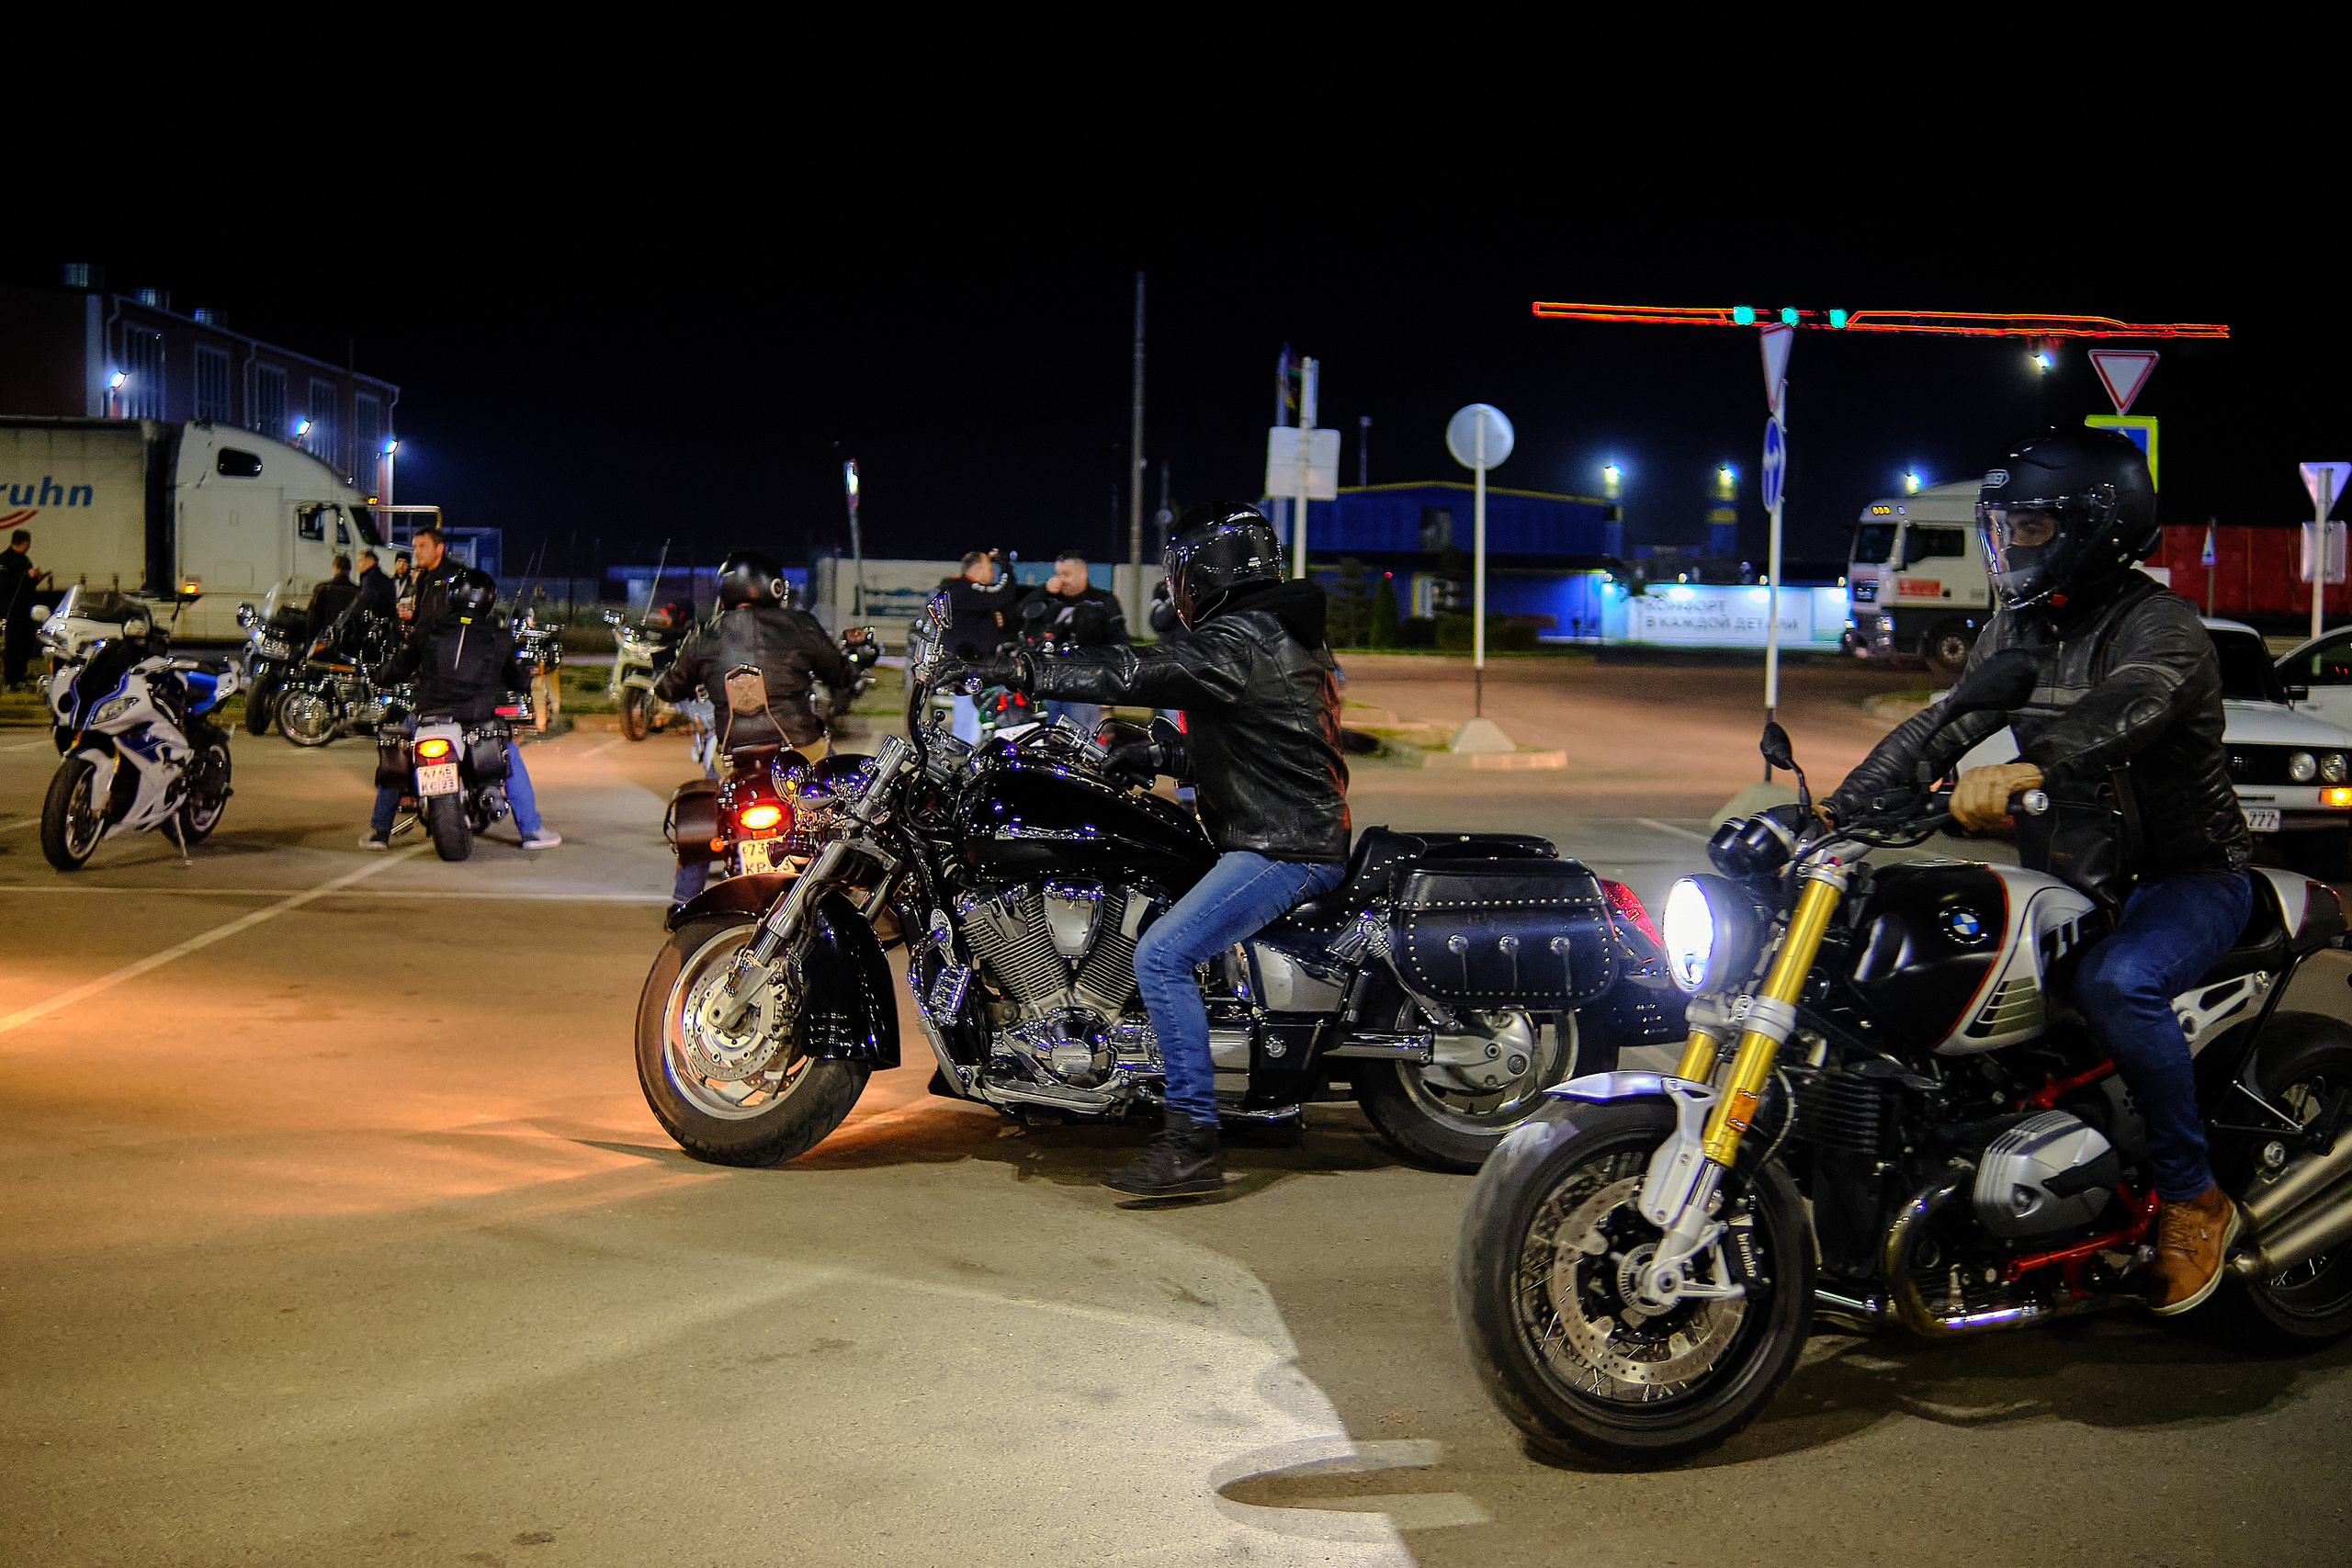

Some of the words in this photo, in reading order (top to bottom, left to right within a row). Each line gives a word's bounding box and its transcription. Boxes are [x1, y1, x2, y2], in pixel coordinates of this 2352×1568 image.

[1645, 617, 1656, 628] В
[1659, 615, 1730, 631] КАЖДОЙ
[1736, 1233, 1757, 1277] brembo
